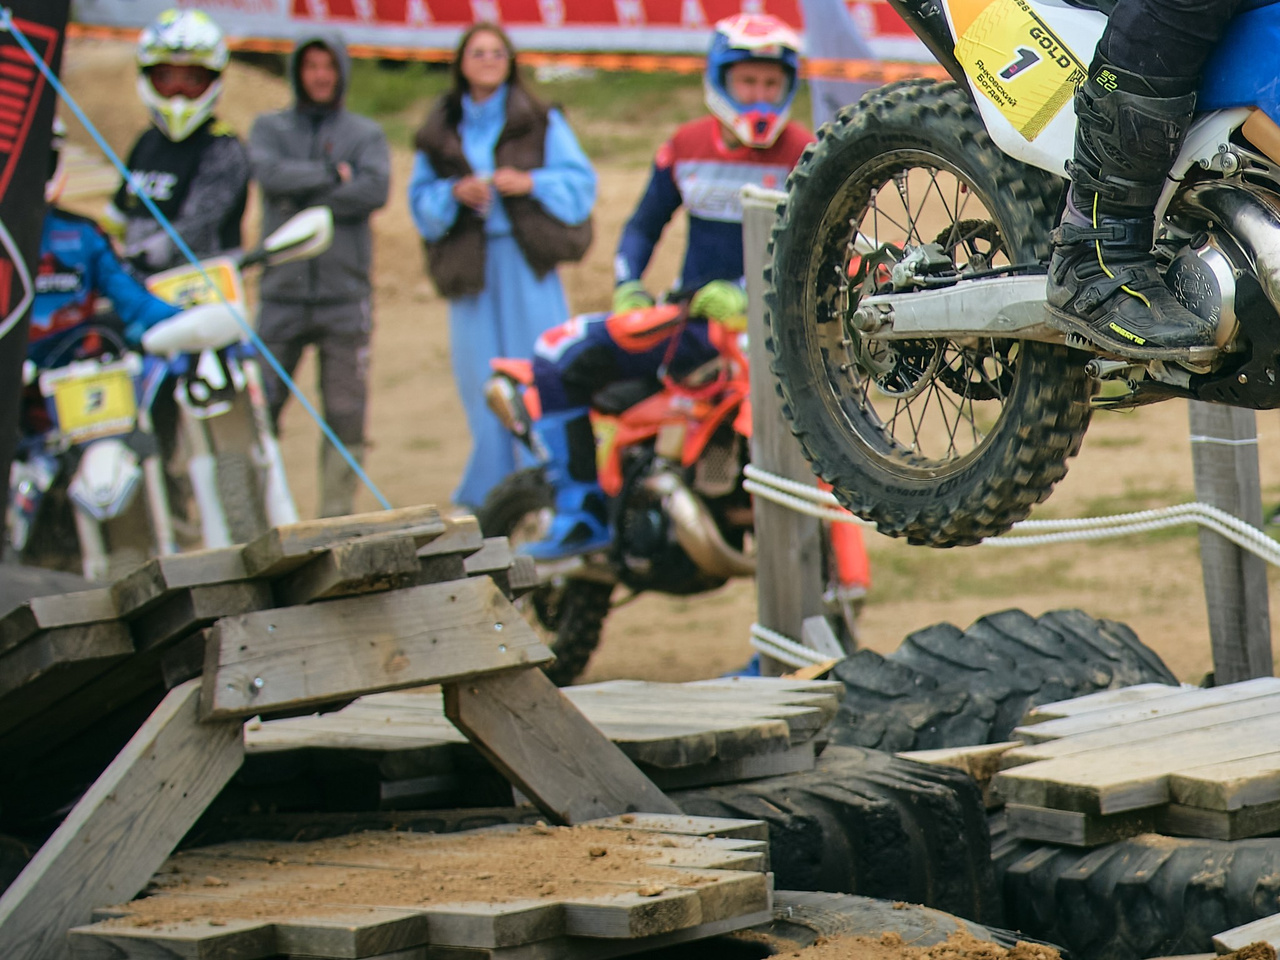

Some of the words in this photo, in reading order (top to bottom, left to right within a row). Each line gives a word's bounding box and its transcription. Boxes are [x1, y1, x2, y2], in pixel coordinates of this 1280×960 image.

[999, 47, 1041, 81] 1
[1029, 26, 1071, 69] GOLD
[975, 59, 1018, 108] Янковский
[976, 73, 1006, 107] Богдан
